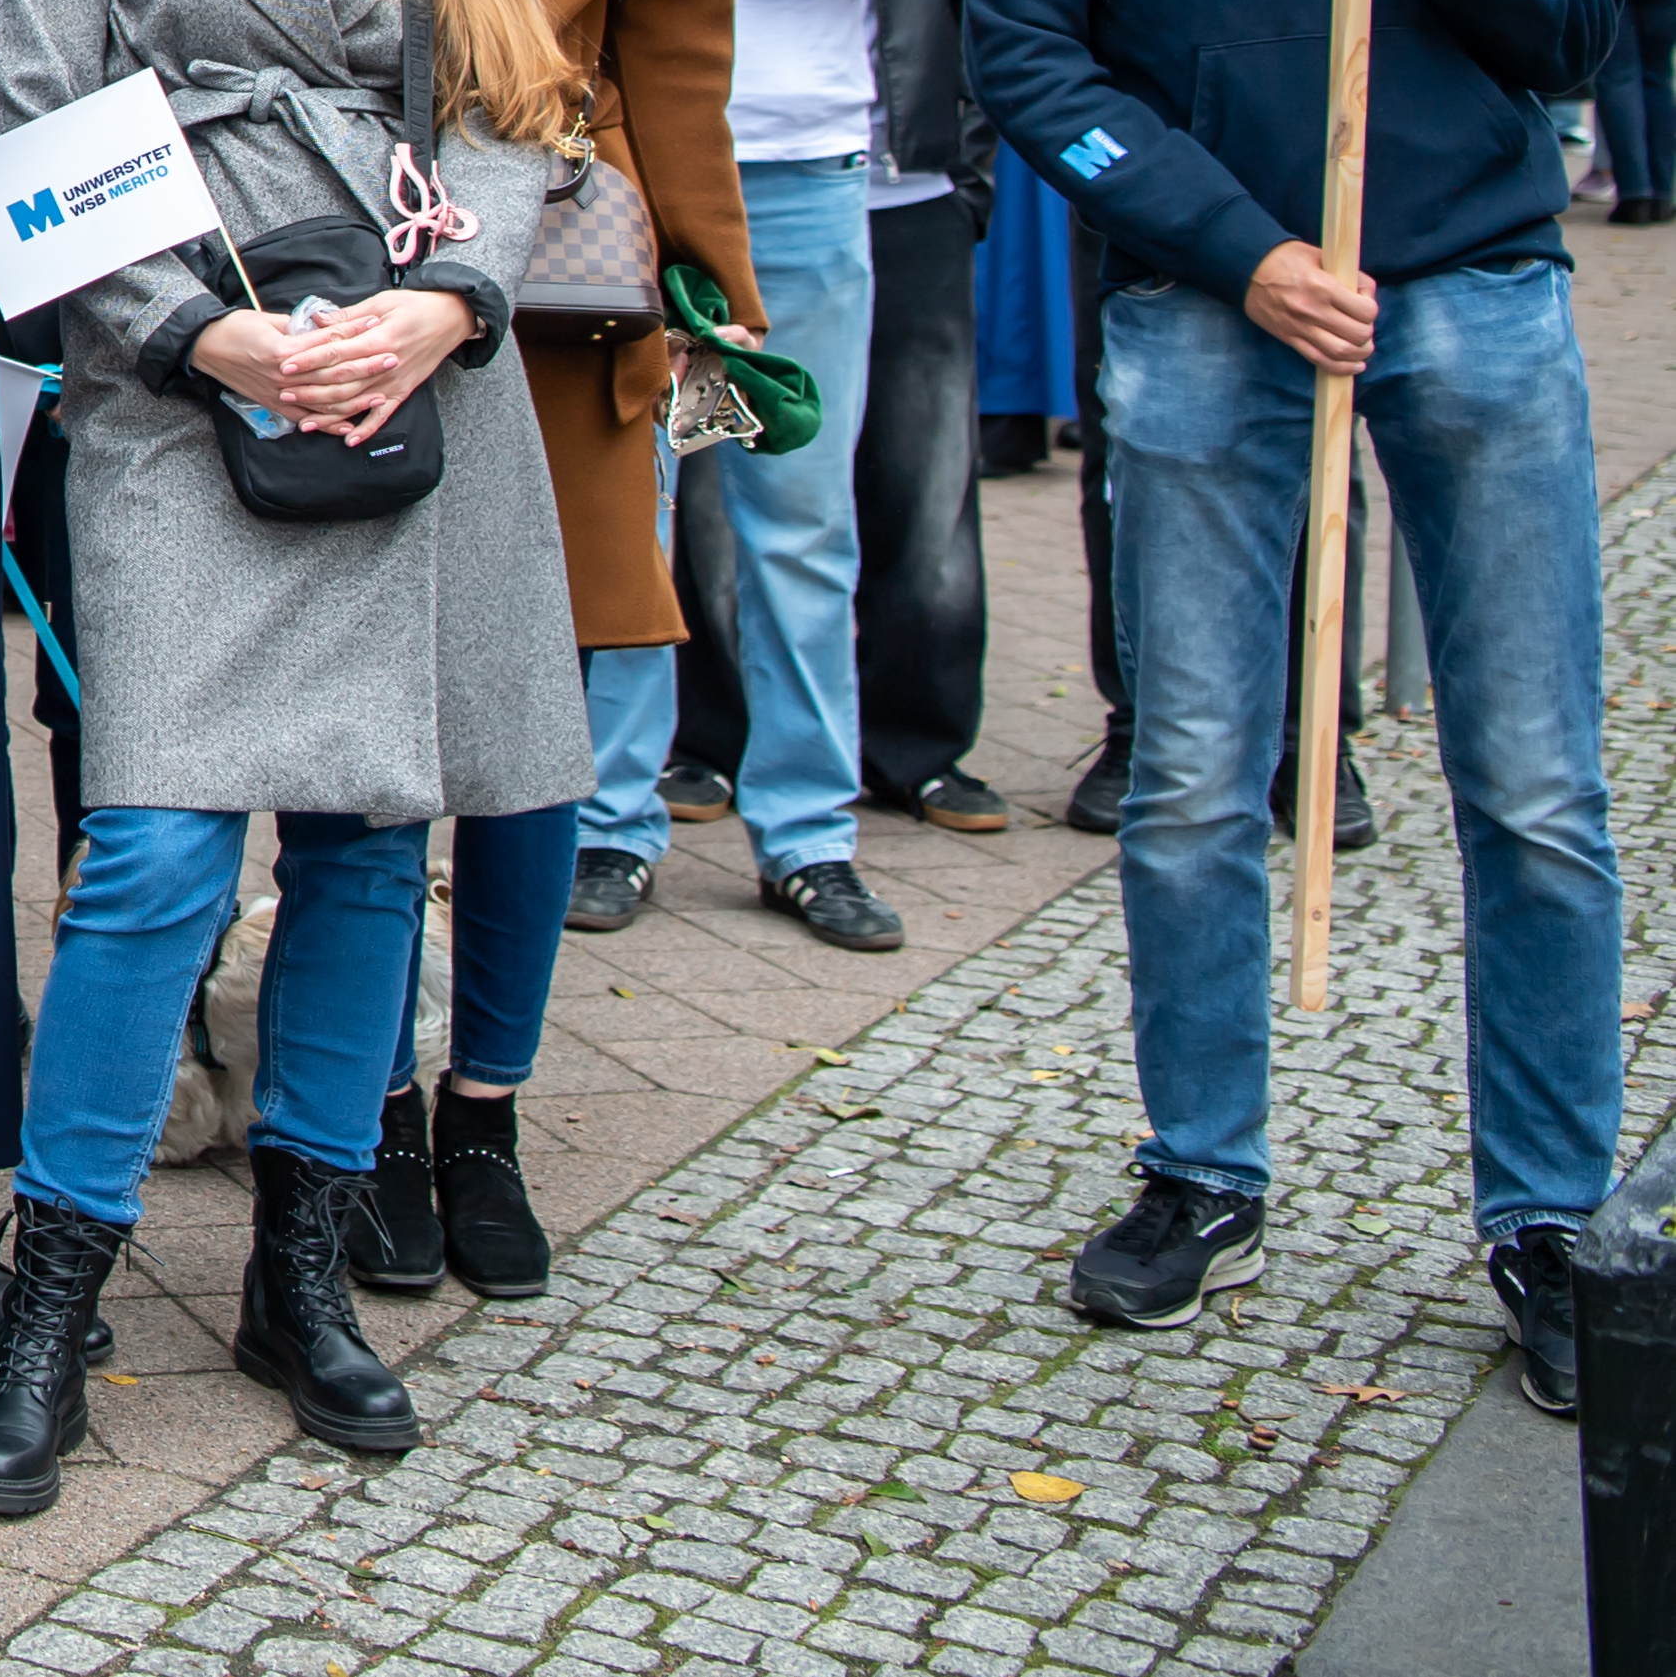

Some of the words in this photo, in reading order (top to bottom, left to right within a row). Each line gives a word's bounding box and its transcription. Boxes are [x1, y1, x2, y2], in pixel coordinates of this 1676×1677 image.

[62, 143, 173, 202] UNIWERSYTET
[69, 193, 107, 217] WSB
[107, 165, 168, 200] MERITO
[5, 187, 65, 242] M
